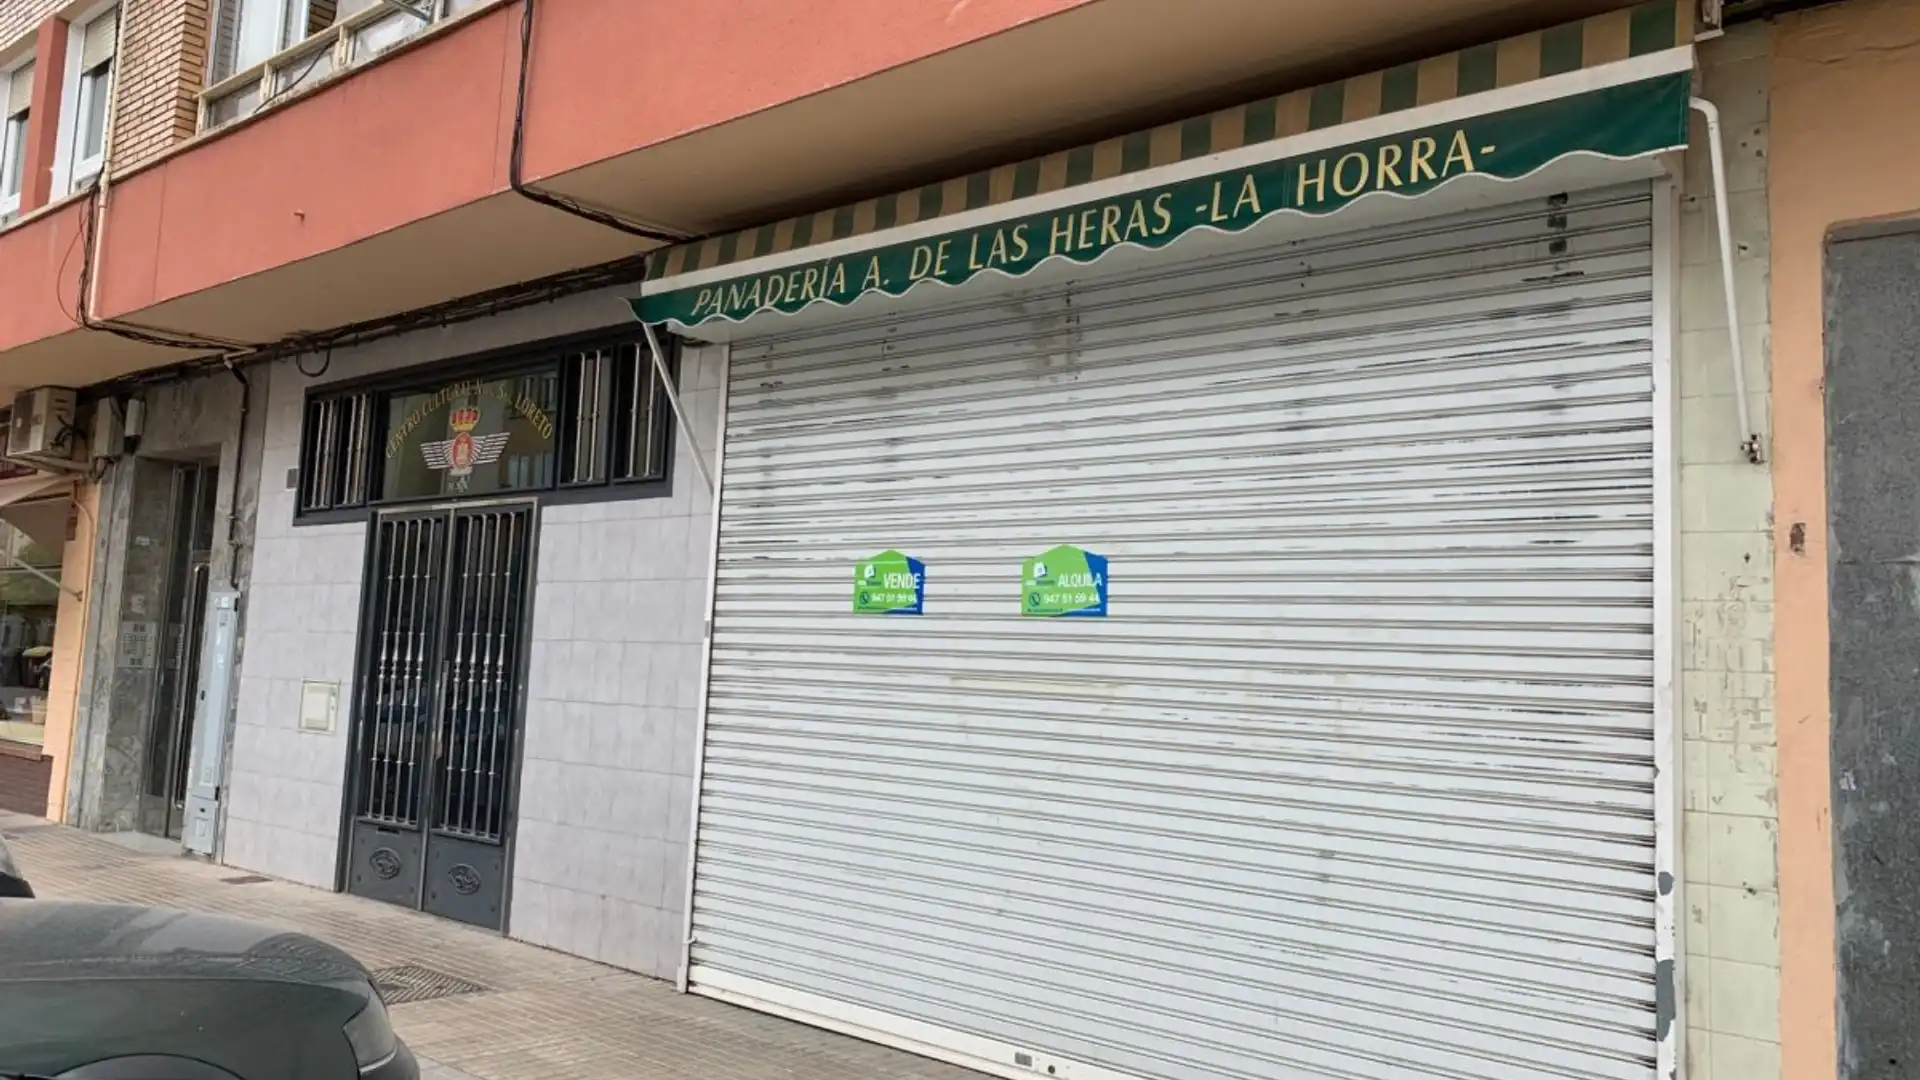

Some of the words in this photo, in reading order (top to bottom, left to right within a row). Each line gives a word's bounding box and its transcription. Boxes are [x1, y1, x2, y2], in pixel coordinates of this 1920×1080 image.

[691, 258, 846, 316] PANADERÍA
[861, 255, 891, 297] A.
[908, 239, 952, 281] DE
[968, 223, 1029, 271] LAS
[1048, 192, 1173, 255] HERAS
[515, 391, 553, 440] LORETO
[884, 572, 921, 589] VENDE
[1057, 572, 1103, 588] ALQUILA
[1043, 592, 1060, 604] 947
